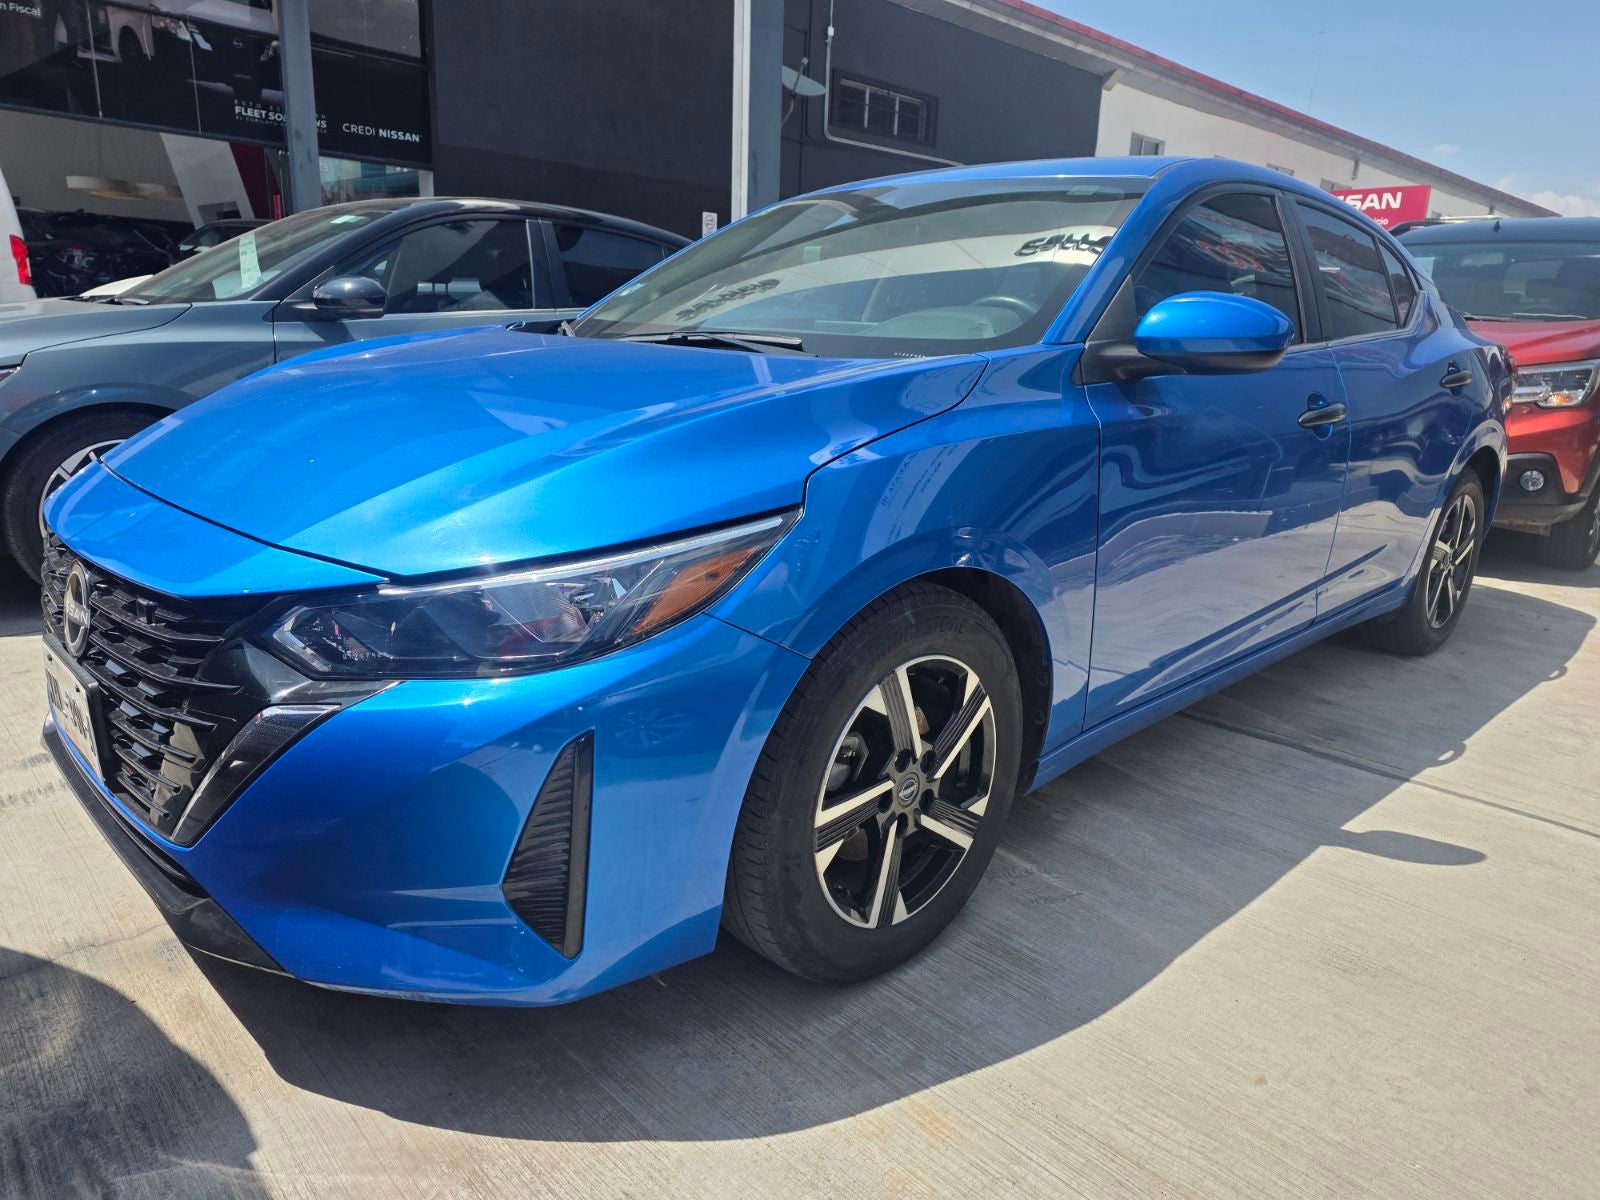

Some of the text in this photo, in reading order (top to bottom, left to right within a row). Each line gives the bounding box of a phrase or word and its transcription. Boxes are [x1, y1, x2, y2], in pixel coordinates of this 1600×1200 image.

[9, 3, 41, 16] Fiscal
[235, 106, 267, 119] FLEET
[342, 123, 376, 136] CREDI
[379, 128, 420, 143] NISSAN
[1336, 191, 1403, 211] SAN
